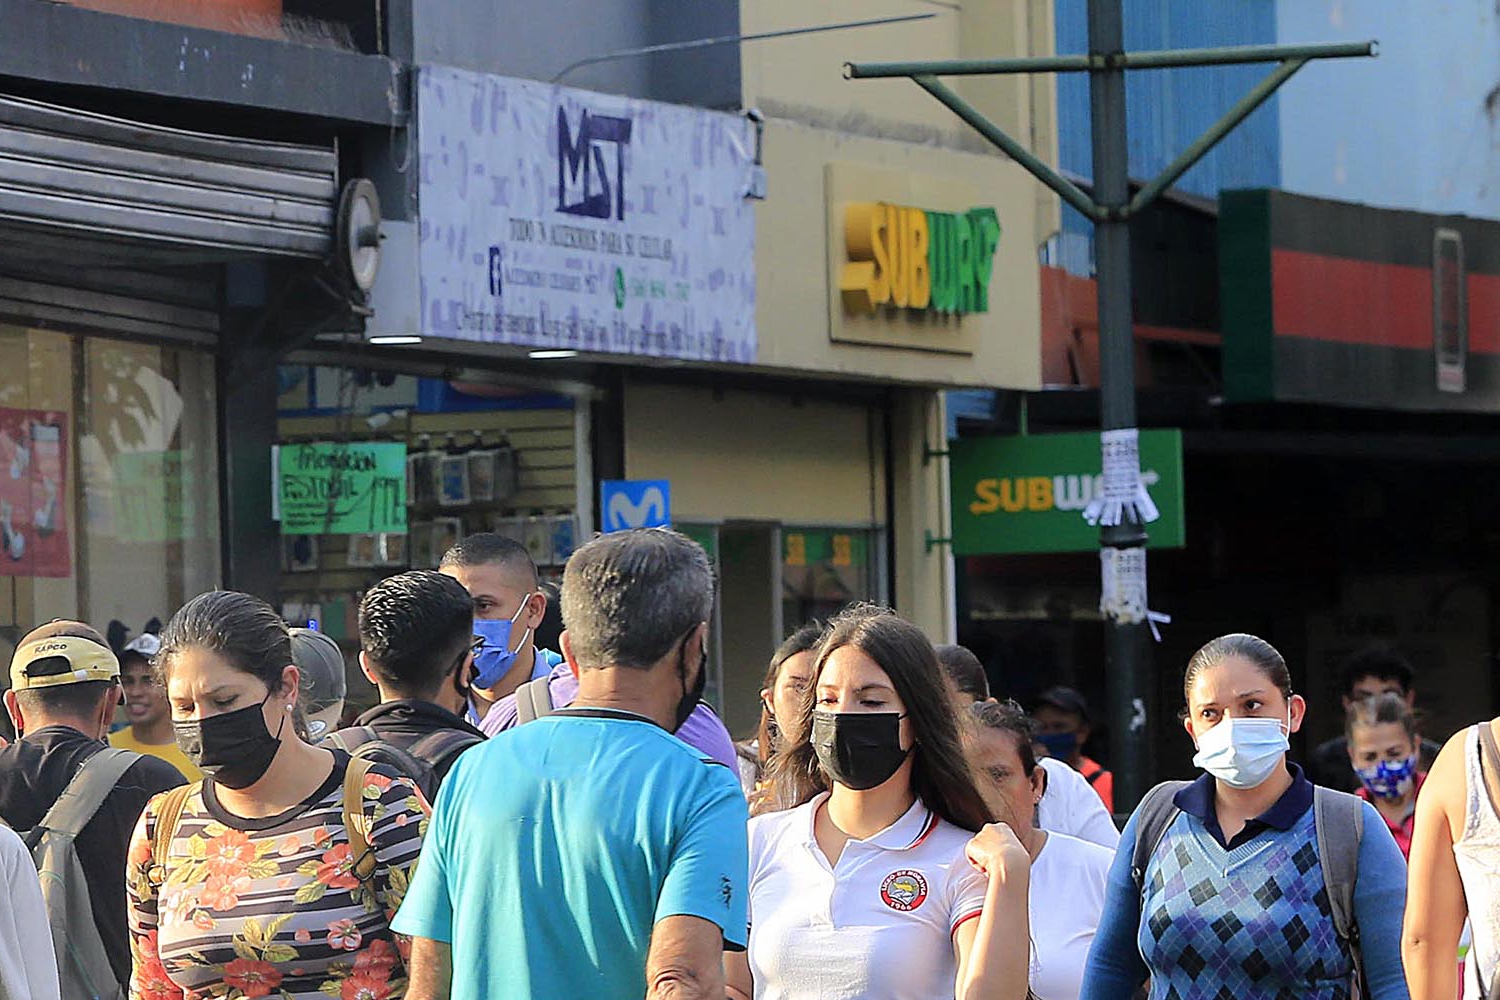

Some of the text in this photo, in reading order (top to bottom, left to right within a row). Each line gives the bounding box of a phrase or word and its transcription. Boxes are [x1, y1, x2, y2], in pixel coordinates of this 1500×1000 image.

[555, 105, 632, 221] MST
[845, 203, 1002, 314] SUBWAY
[890, 901, 913, 911] 1966
